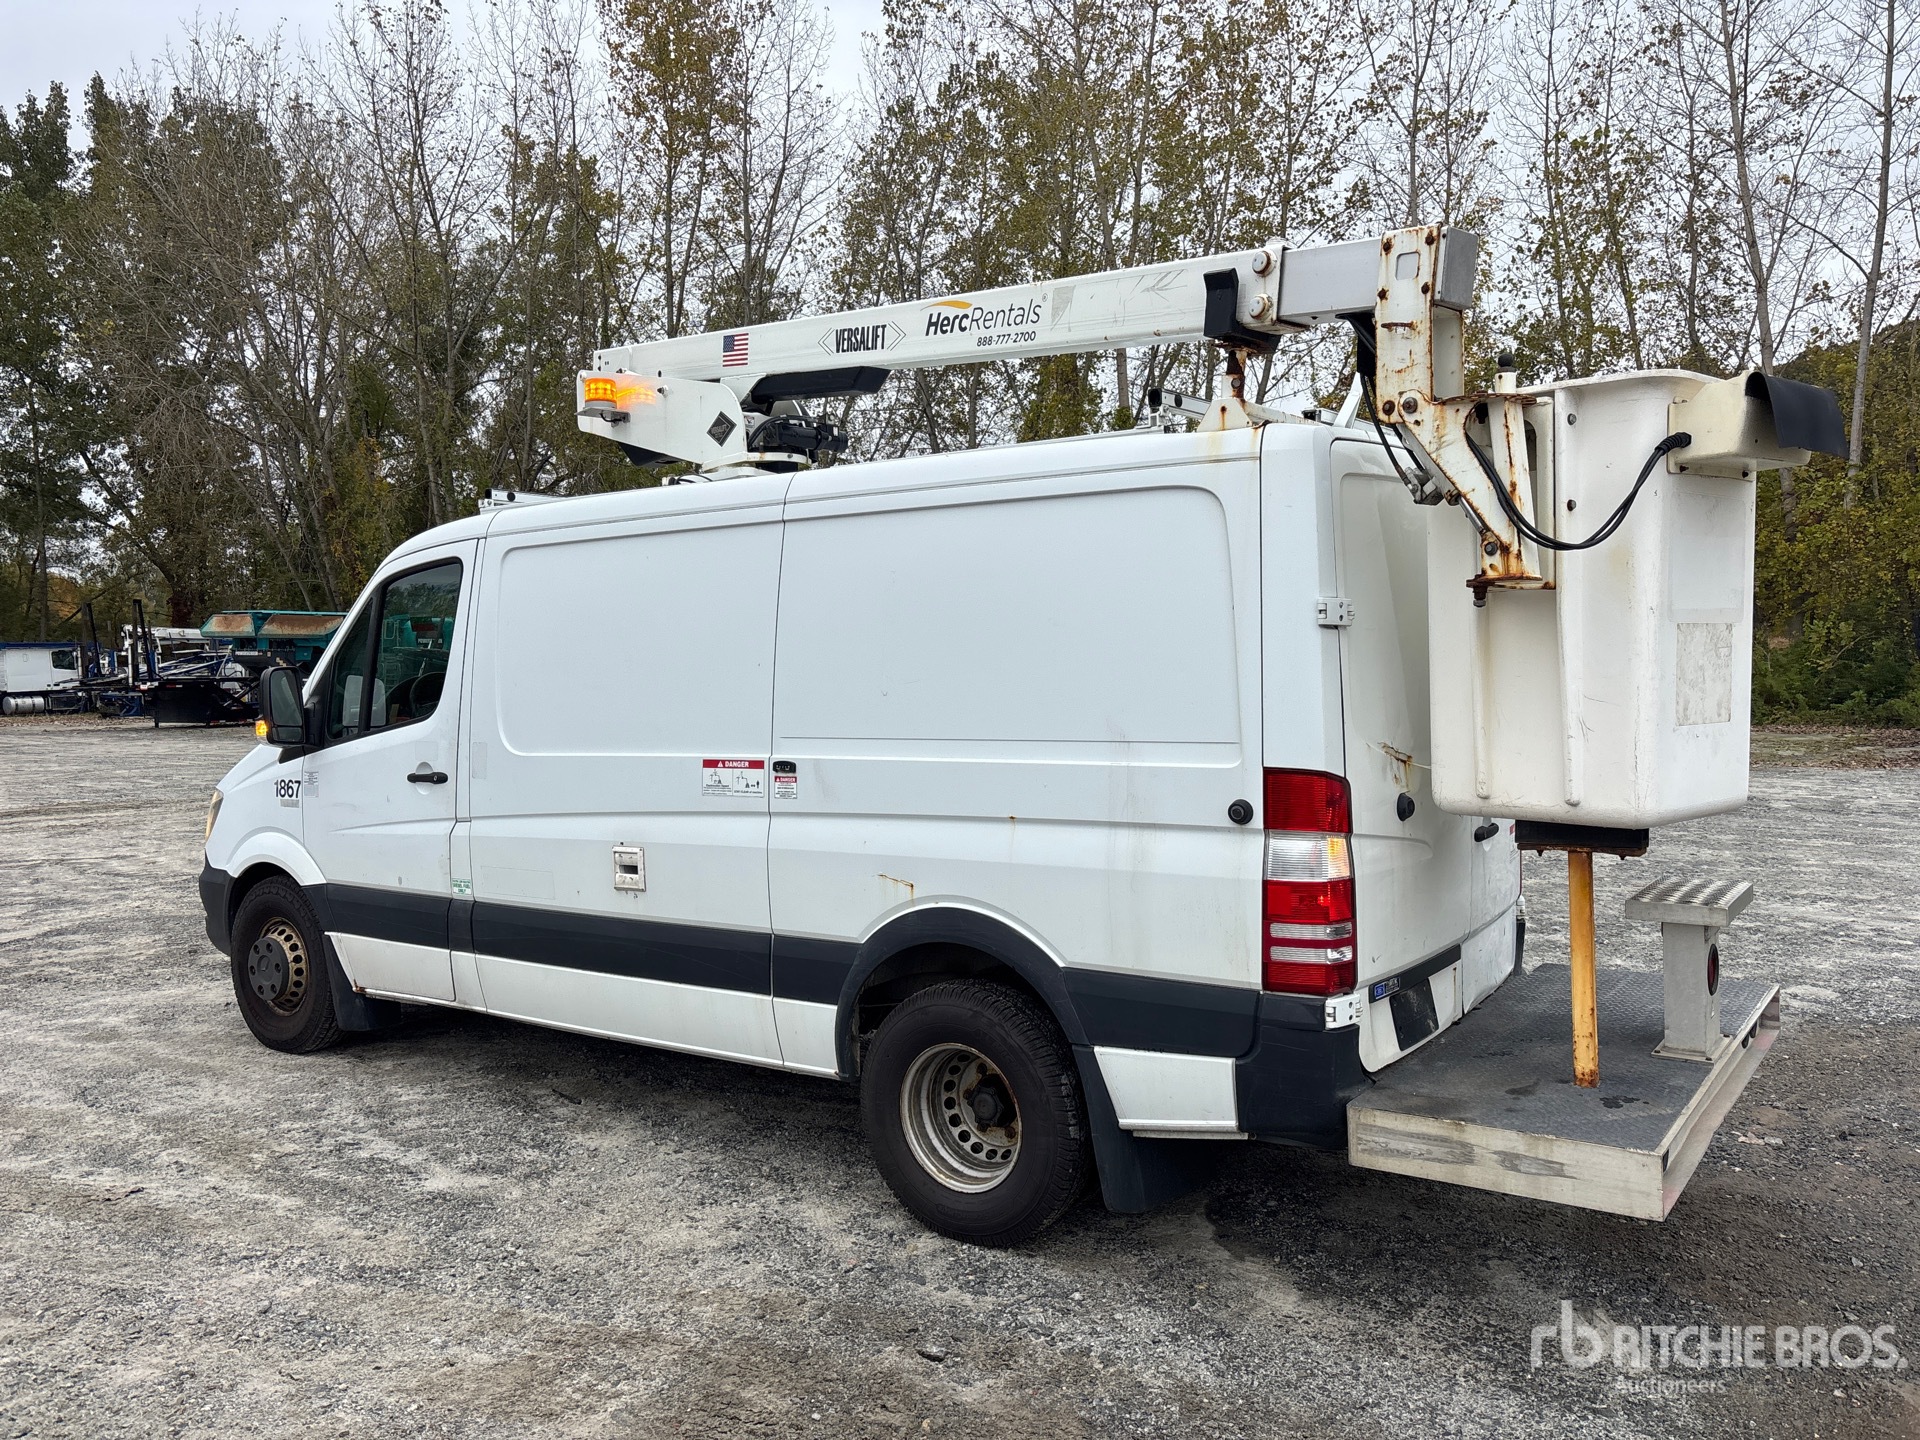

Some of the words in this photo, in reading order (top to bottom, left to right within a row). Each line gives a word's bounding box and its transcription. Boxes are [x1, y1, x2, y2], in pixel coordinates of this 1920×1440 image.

[925, 299, 1042, 337] HercRentals
[835, 324, 887, 354] VERSALIFT
[976, 330, 1037, 347] 888-777-2700
[273, 779, 302, 799] 1867
